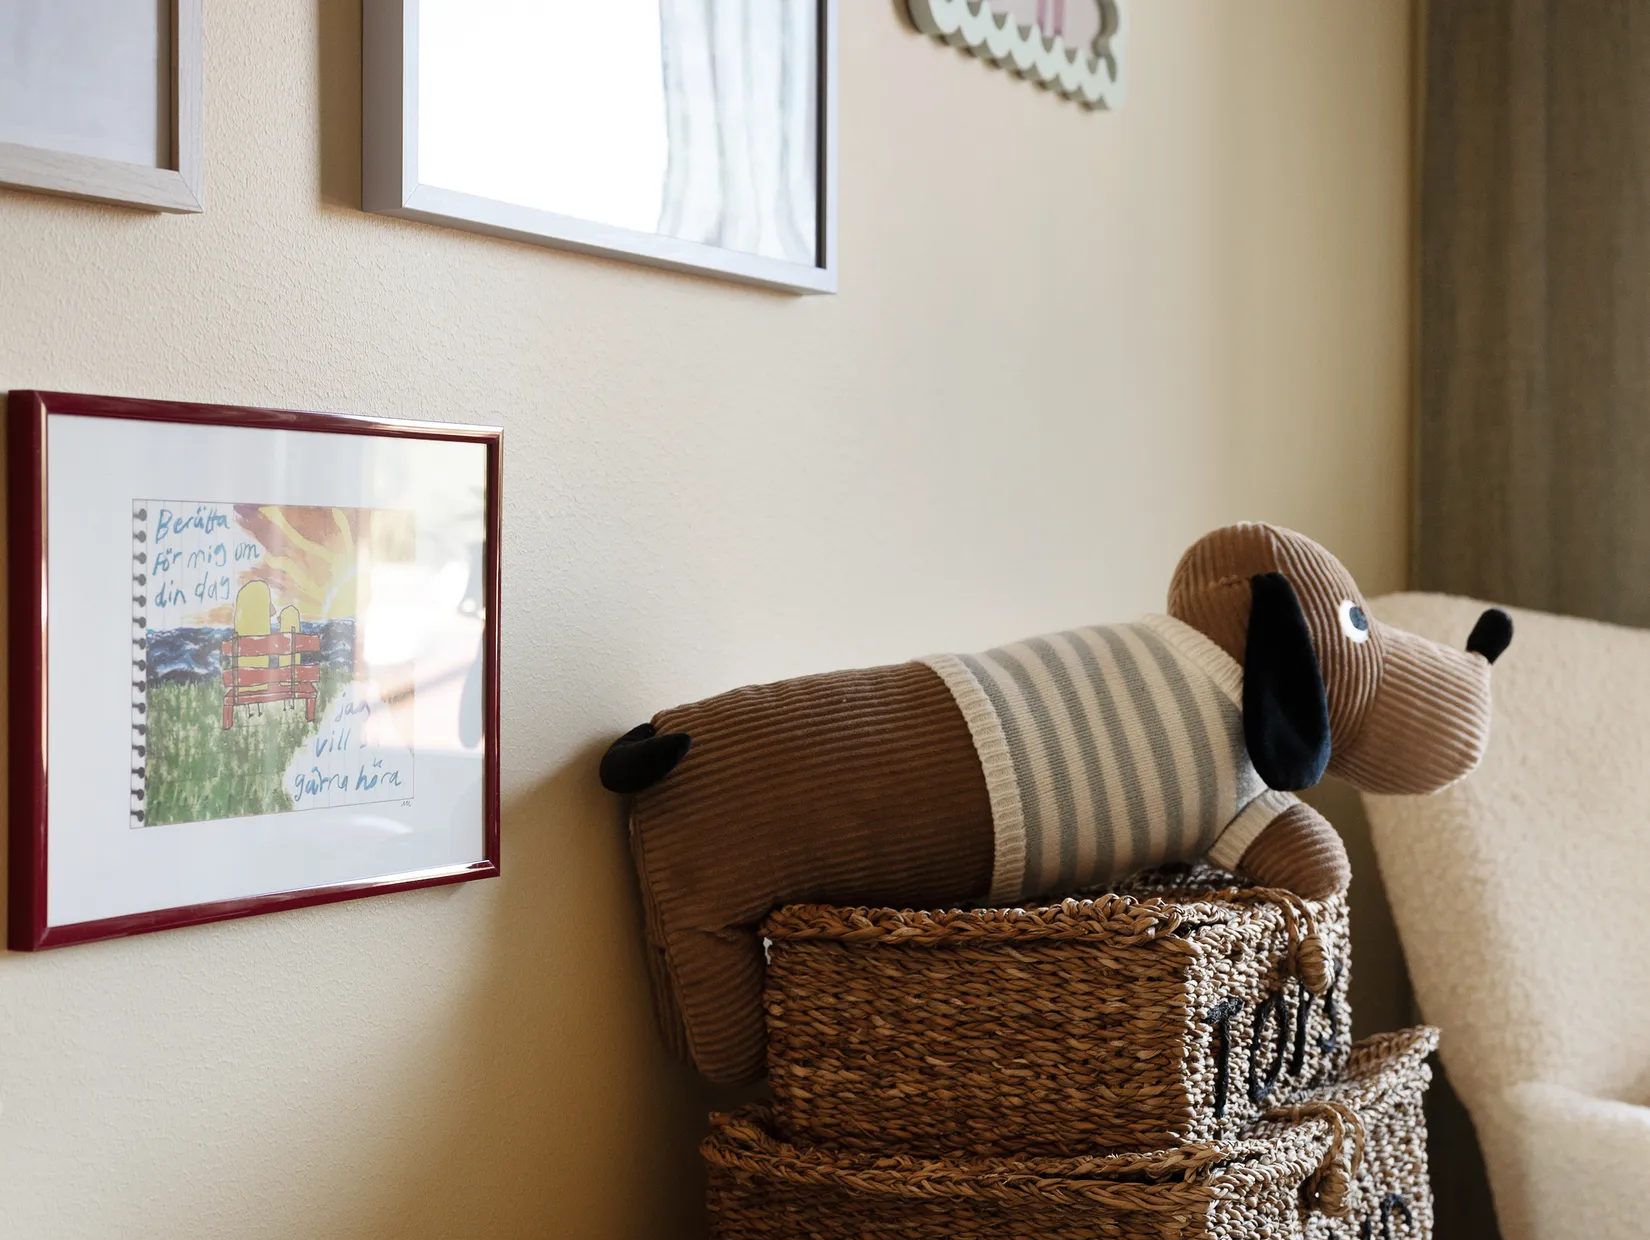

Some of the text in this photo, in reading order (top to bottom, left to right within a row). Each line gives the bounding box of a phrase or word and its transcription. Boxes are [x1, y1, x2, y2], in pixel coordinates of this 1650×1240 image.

[155, 506, 230, 544] Berätta
[187, 543, 227, 568] mig
[235, 541, 260, 562] om
[154, 571, 231, 608] din dag
[315, 727, 352, 758] vill
[355, 758, 402, 791] höra
